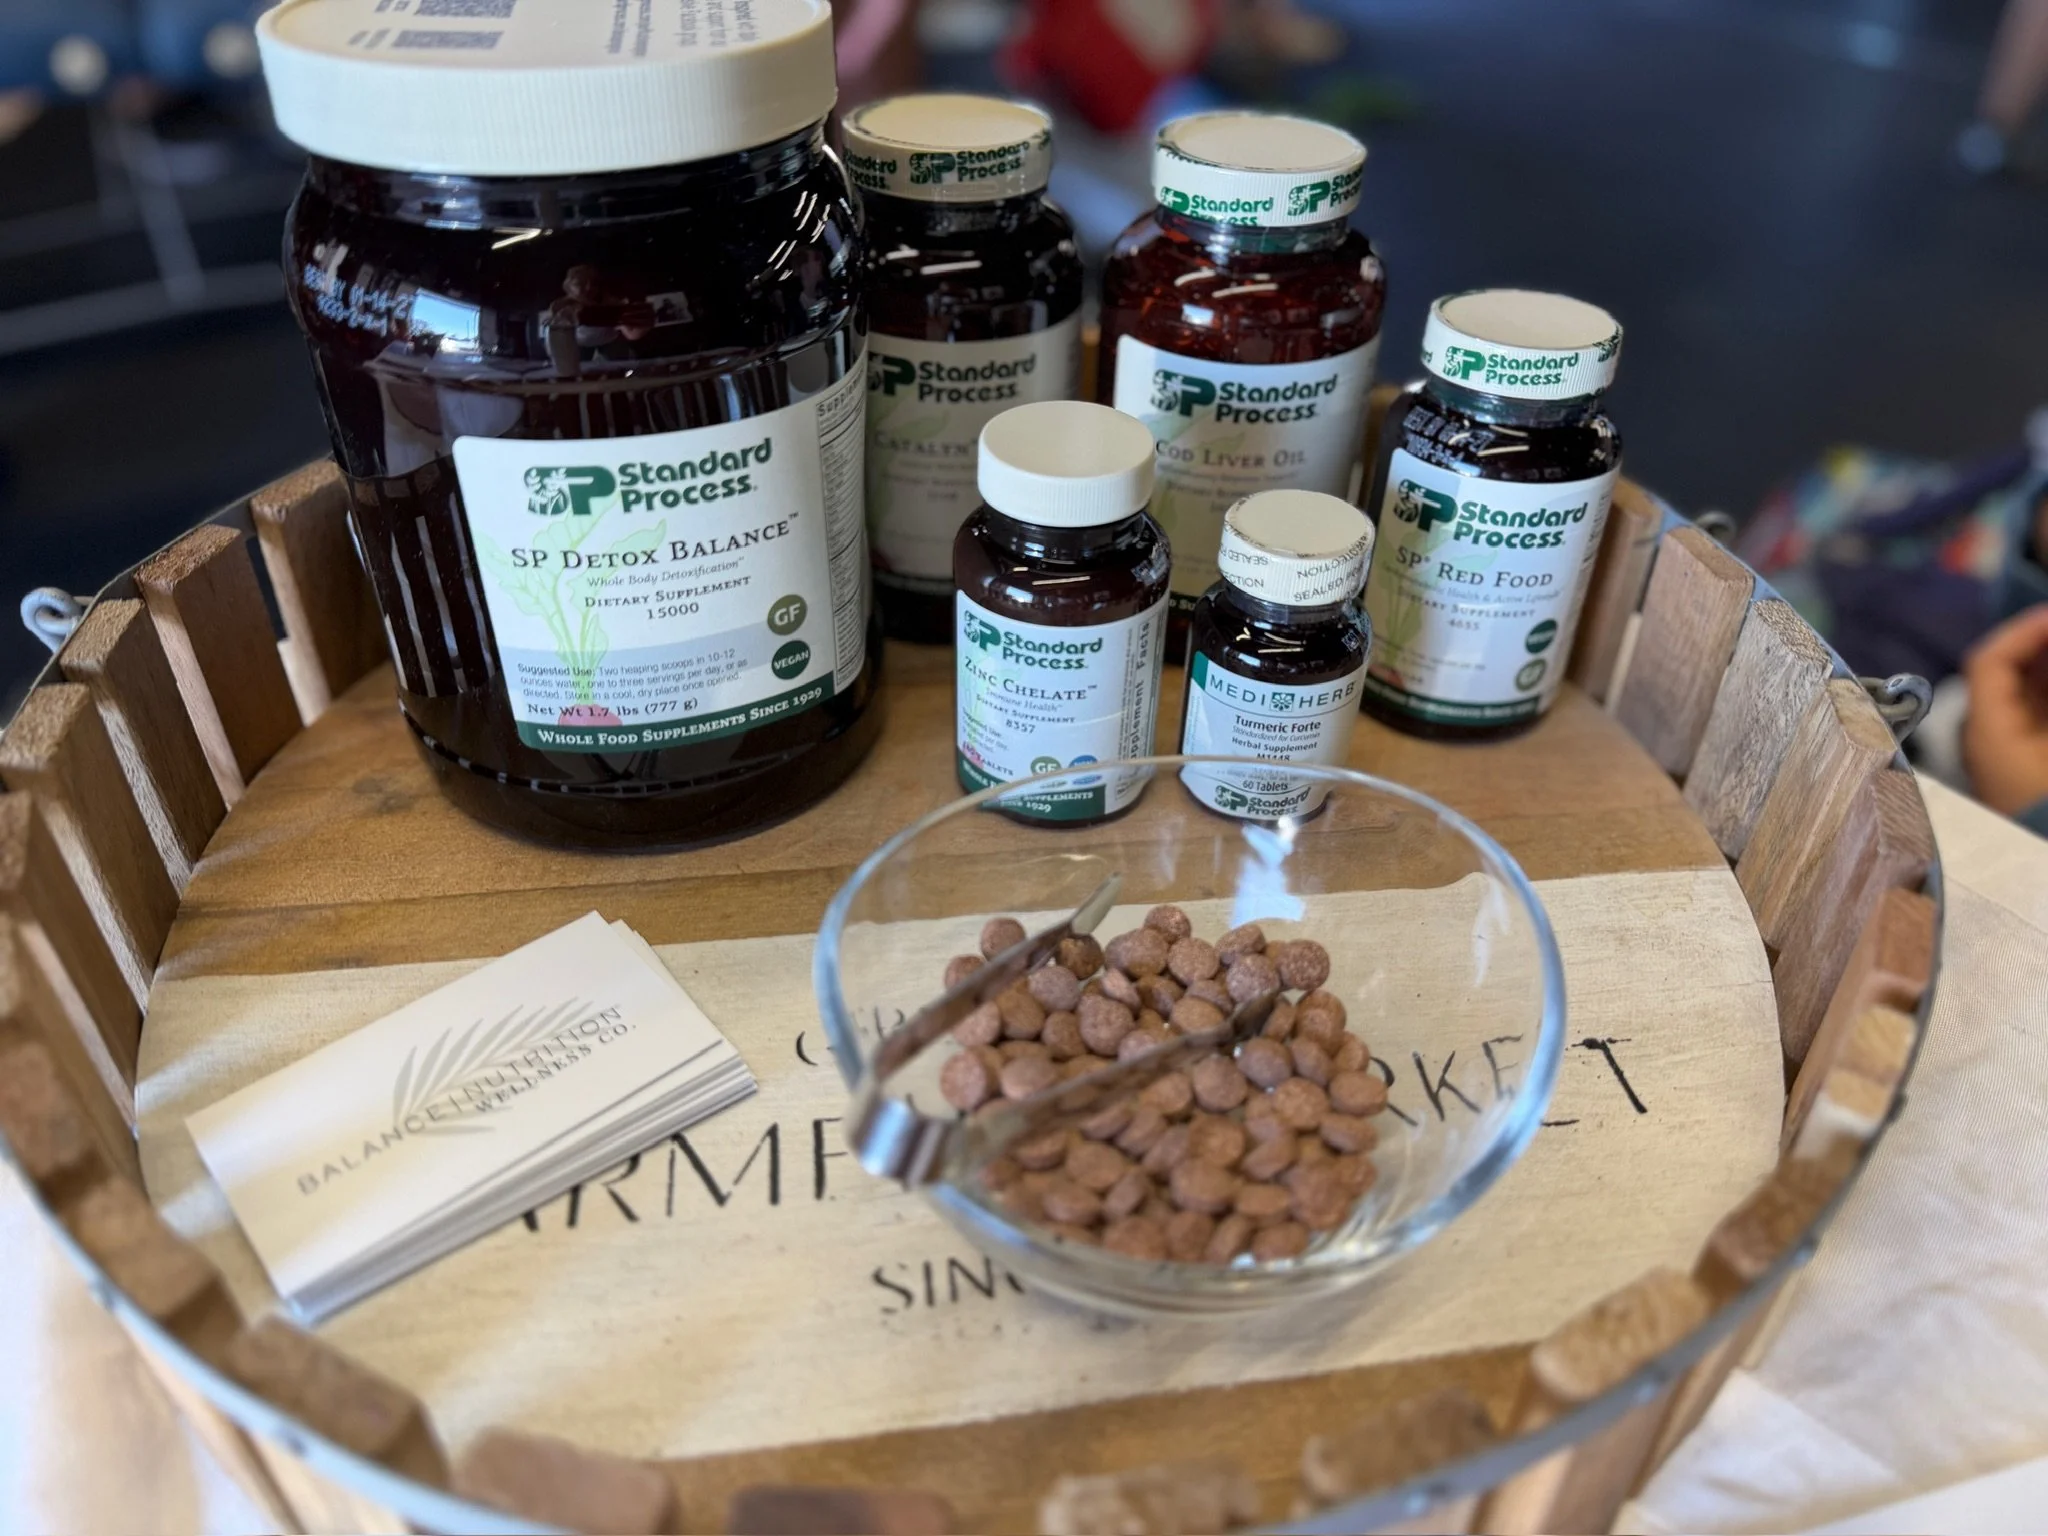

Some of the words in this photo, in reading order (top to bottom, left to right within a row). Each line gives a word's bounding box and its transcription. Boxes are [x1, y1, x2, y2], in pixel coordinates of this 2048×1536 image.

[957, 157, 1022, 182] Process
[1191, 194, 1274, 213] Standard
[918, 354, 1037, 383] Standard
[1487, 352, 1580, 371] Standard
[1485, 368, 1563, 386] Process
[917, 381, 1018, 403] Process
[1219, 374, 1338, 404] Standard
[1215, 402, 1318, 424] Process
[619, 437, 772, 487] Standard
[1203, 448, 1266, 468] LIVER
[620, 474, 757, 514] Process
[1459, 501, 1588, 528] Standard
[1453, 522, 1565, 550] Process
[511, 548, 549, 569] SP
[561, 547, 659, 570] DETOX
[587, 577, 625, 588] Whole
[628, 572, 658, 587] Body
[1437, 561, 1485, 586] RED
[1493, 571, 1554, 589] FOOD
[584, 597, 650, 608] DIETARY
[655, 576, 752, 603] SUPPLEMENT
[647, 602, 700, 620] 15000
[774, 604, 802, 626] GF
[1451, 603, 1536, 619] SUPPLEMENT
[1003, 631, 1103, 655] Standard
[1136, 622, 1151, 671] Facts
[517, 662, 570, 677] Suggested
[572, 664, 595, 677] Use:
[599, 665, 619, 676] Two
[620, 661, 659, 677] heaping
[661, 657, 694, 674] scoops
[708, 648, 736, 663] 10-12
[773, 650, 810, 670] VEGAN
[1002, 648, 1088, 670] Process
[646, 670, 687, 684] servings
[688, 668, 704, 680] per
[706, 664, 727, 679] day,
[965, 656, 998, 686] ZINC
[655, 682, 681, 696] place
[682, 678, 704, 690] once
[707, 671, 743, 688] opened.
[1209, 673, 1266, 706] MEDI
[1298, 679, 1358, 709] HERB
[527, 703, 555, 717] Net
[560, 704, 584, 717] Wt
[589, 703, 609, 717] 1.7
[617, 702, 639, 716] lbs
[644, 700, 680, 714] (777
[683, 697, 699, 711] g)
[536, 728, 595, 746] WHOLE
[598, 730, 638, 745] FOOD
[642, 711, 747, 741] SUPPLEMENTS
[750, 699, 791, 721] SINCE
[793, 686, 823, 707] 1929
[1011, 710, 1076, 723] SUPPLEMENT
[1235, 715, 1289, 734] Turmeric
[1291, 719, 1322, 733] Forte
[1231, 736, 1262, 750] Herbal
[1264, 741, 1319, 755] Supplement
[1243, 780, 1254, 790] 60
[1256, 782, 1289, 792] Tablets
[1248, 786, 1312, 808] Standard
[1026, 802, 1052, 813] 1929
[1247, 804, 1299, 816] Process
[474, 1042, 593, 1115] WELLNESS
[598, 1022, 638, 1046] CO.
